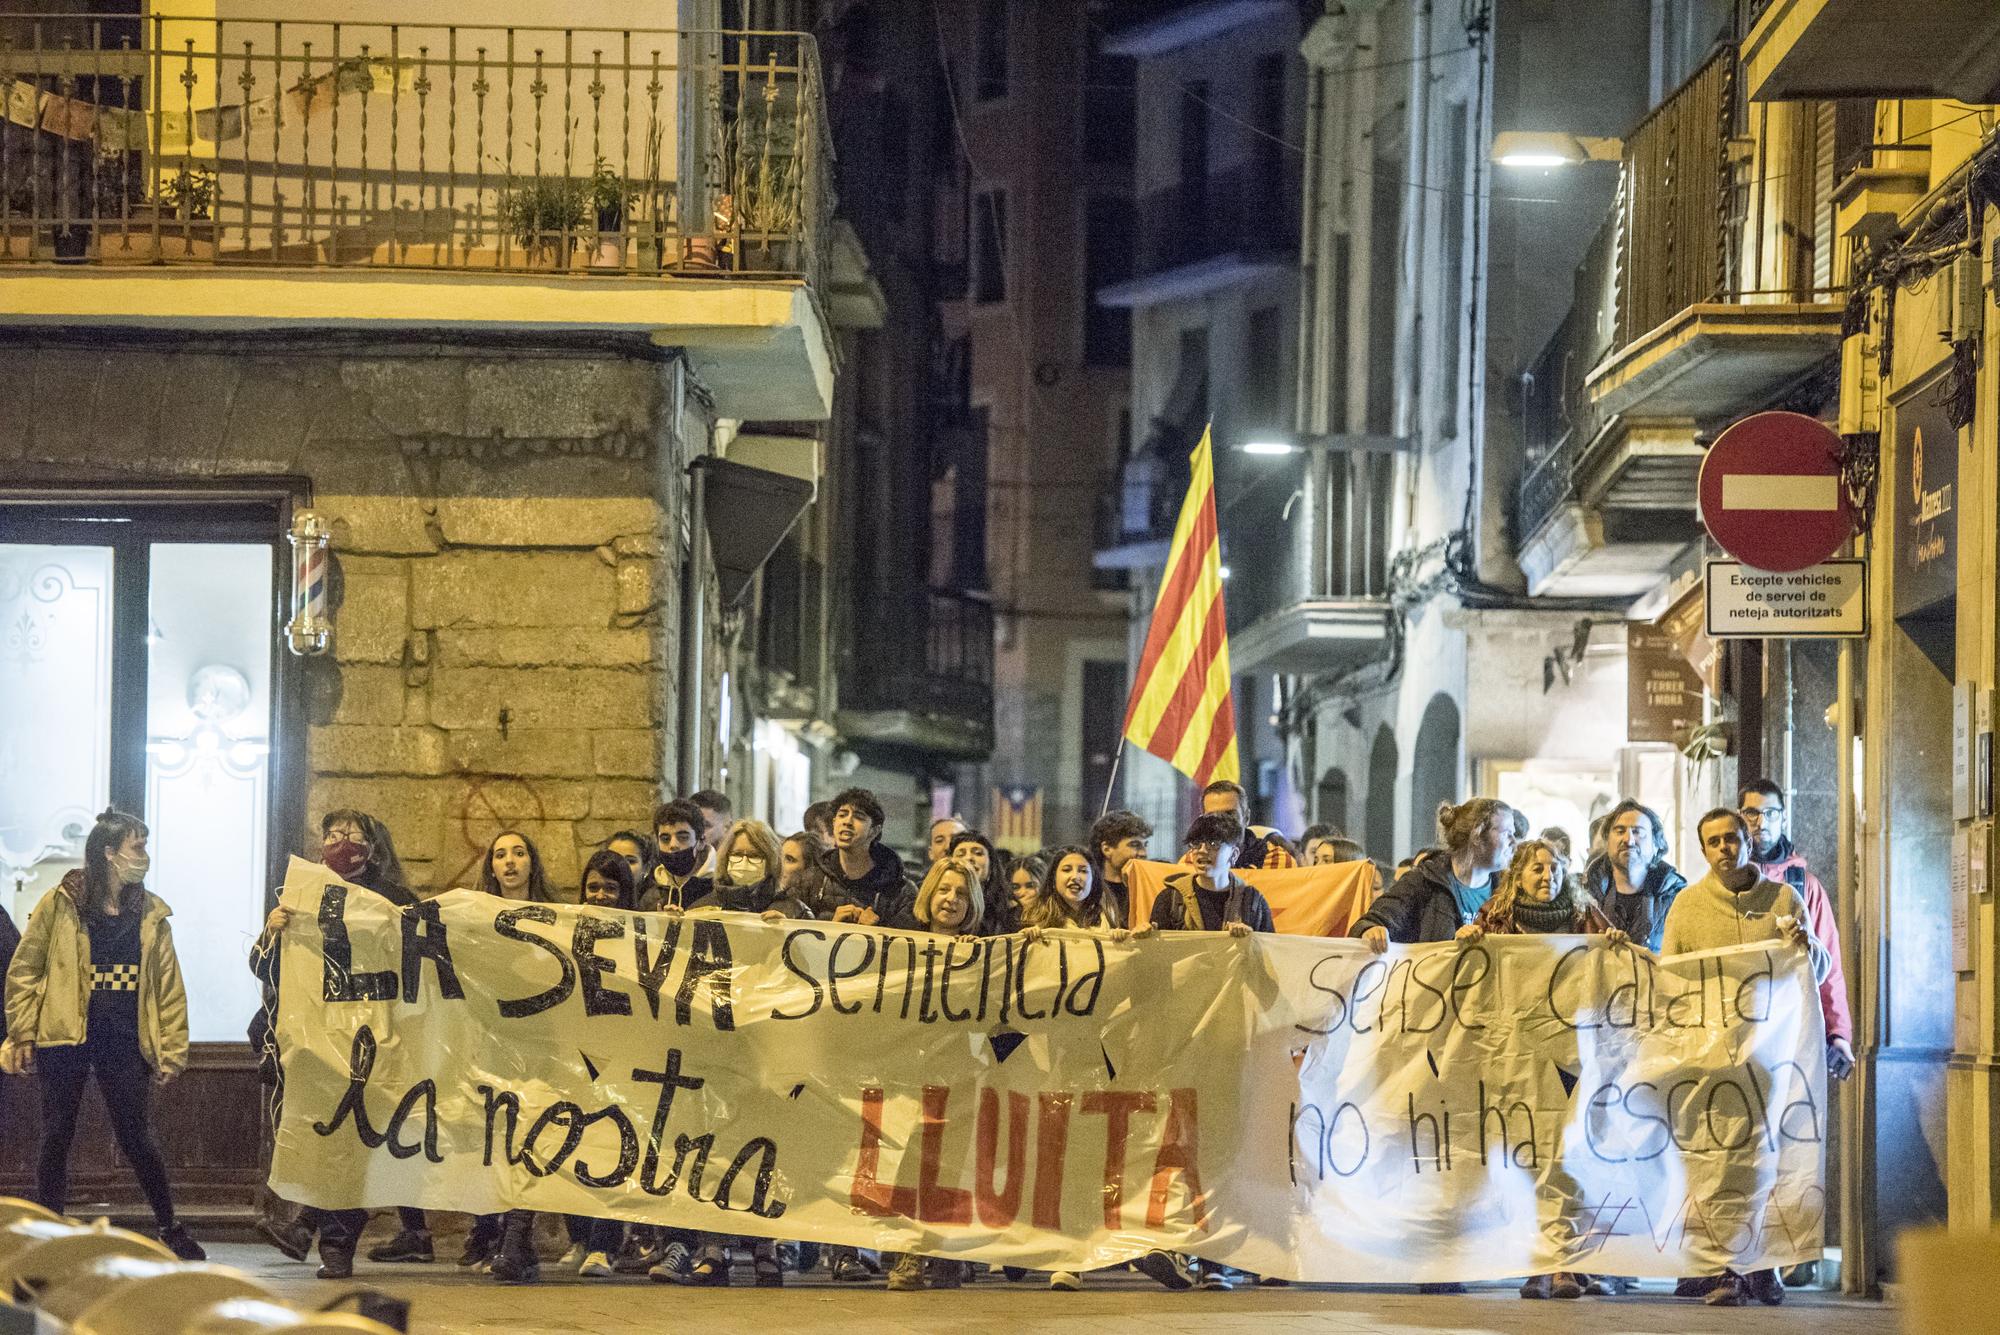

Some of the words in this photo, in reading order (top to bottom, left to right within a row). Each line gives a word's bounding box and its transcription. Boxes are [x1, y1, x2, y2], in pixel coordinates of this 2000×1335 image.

[1730, 608, 1769, 620] neteja
[1773, 606, 1843, 618] autoritzats
[1731, 574, 1783, 587] Excepte
[1787, 574, 1842, 586] vehicles
[1746, 591, 1762, 601] de
[1766, 591, 1805, 601] servei
[1810, 591, 1826, 601] de
[319, 883, 465, 1004] LA
[494, 905, 737, 1031] SEVA
[313, 1025, 444, 1163] la
[479, 1048, 787, 1218] nostra
[850, 1085, 1208, 1233] LLUITA
[1289, 1101, 1370, 1187] no
[1408, 1091, 1453, 1174] hi
[1479, 1080, 1539, 1170] ha
[1584, 1060, 1822, 1164] escola
